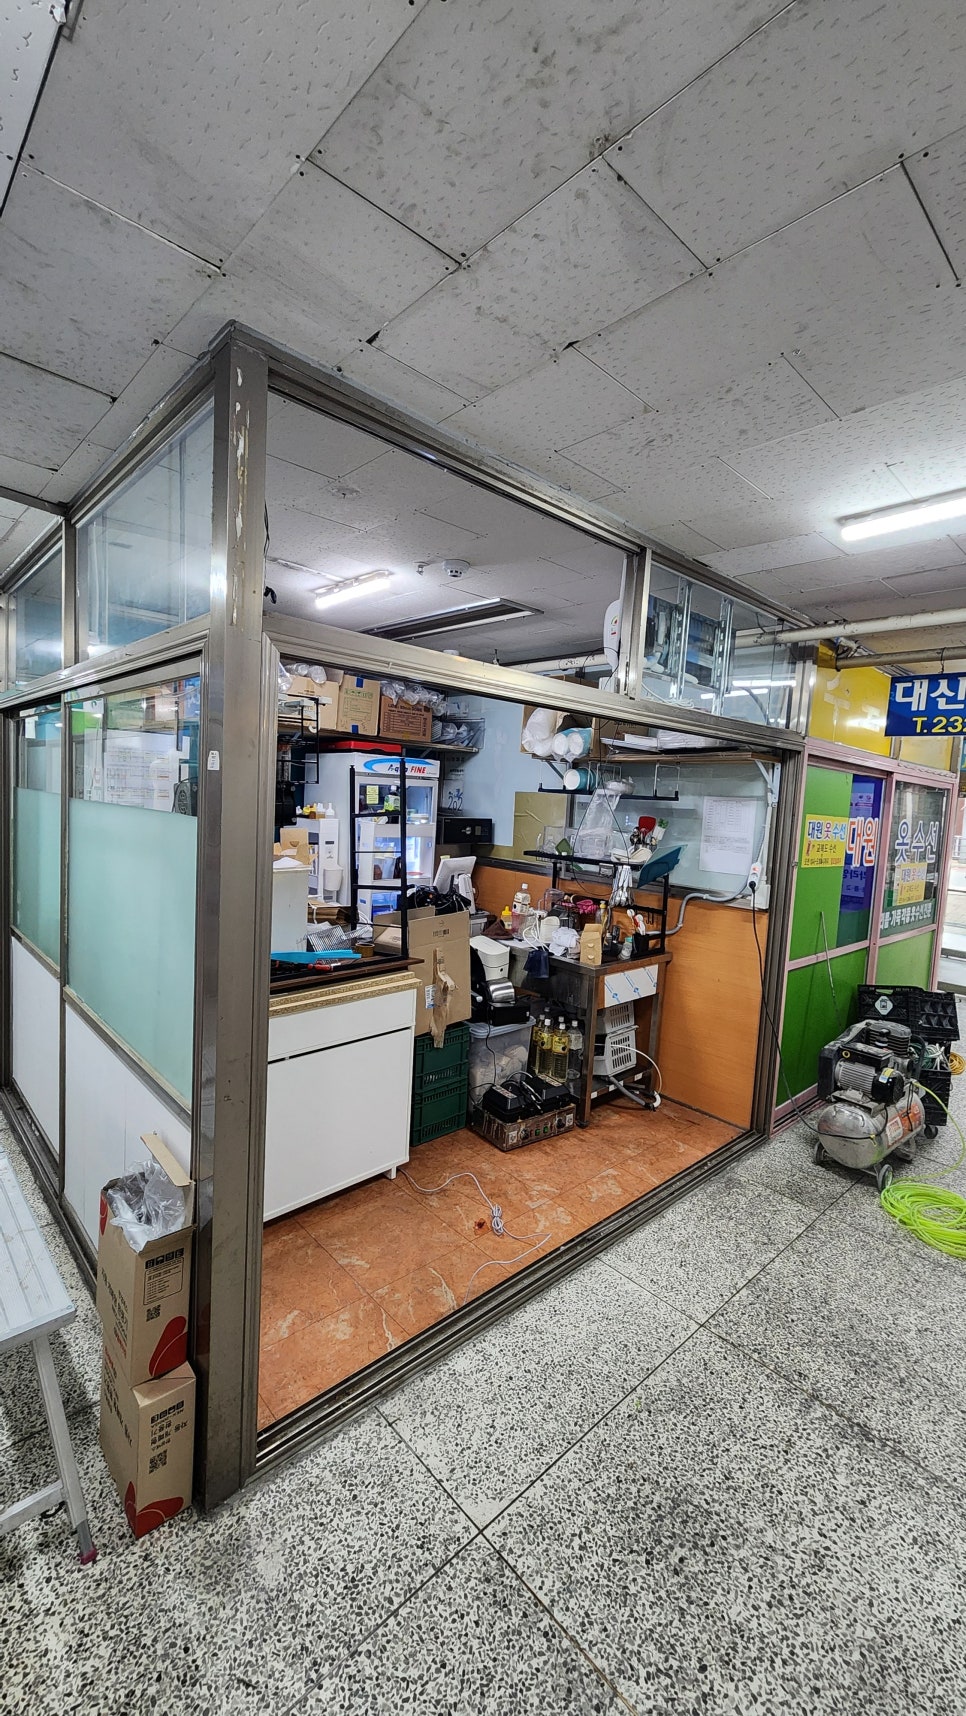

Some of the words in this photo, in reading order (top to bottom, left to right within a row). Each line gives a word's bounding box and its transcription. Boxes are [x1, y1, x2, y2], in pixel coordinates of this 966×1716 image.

[895, 677, 966, 711] 대신
[912, 716, 966, 733] T.23
[410, 766, 427, 774] FINE
[807, 821, 823, 839] 대원
[824, 822, 832, 840] 옷
[832, 823, 846, 841] 수선
[847, 817, 879, 868] 대원
